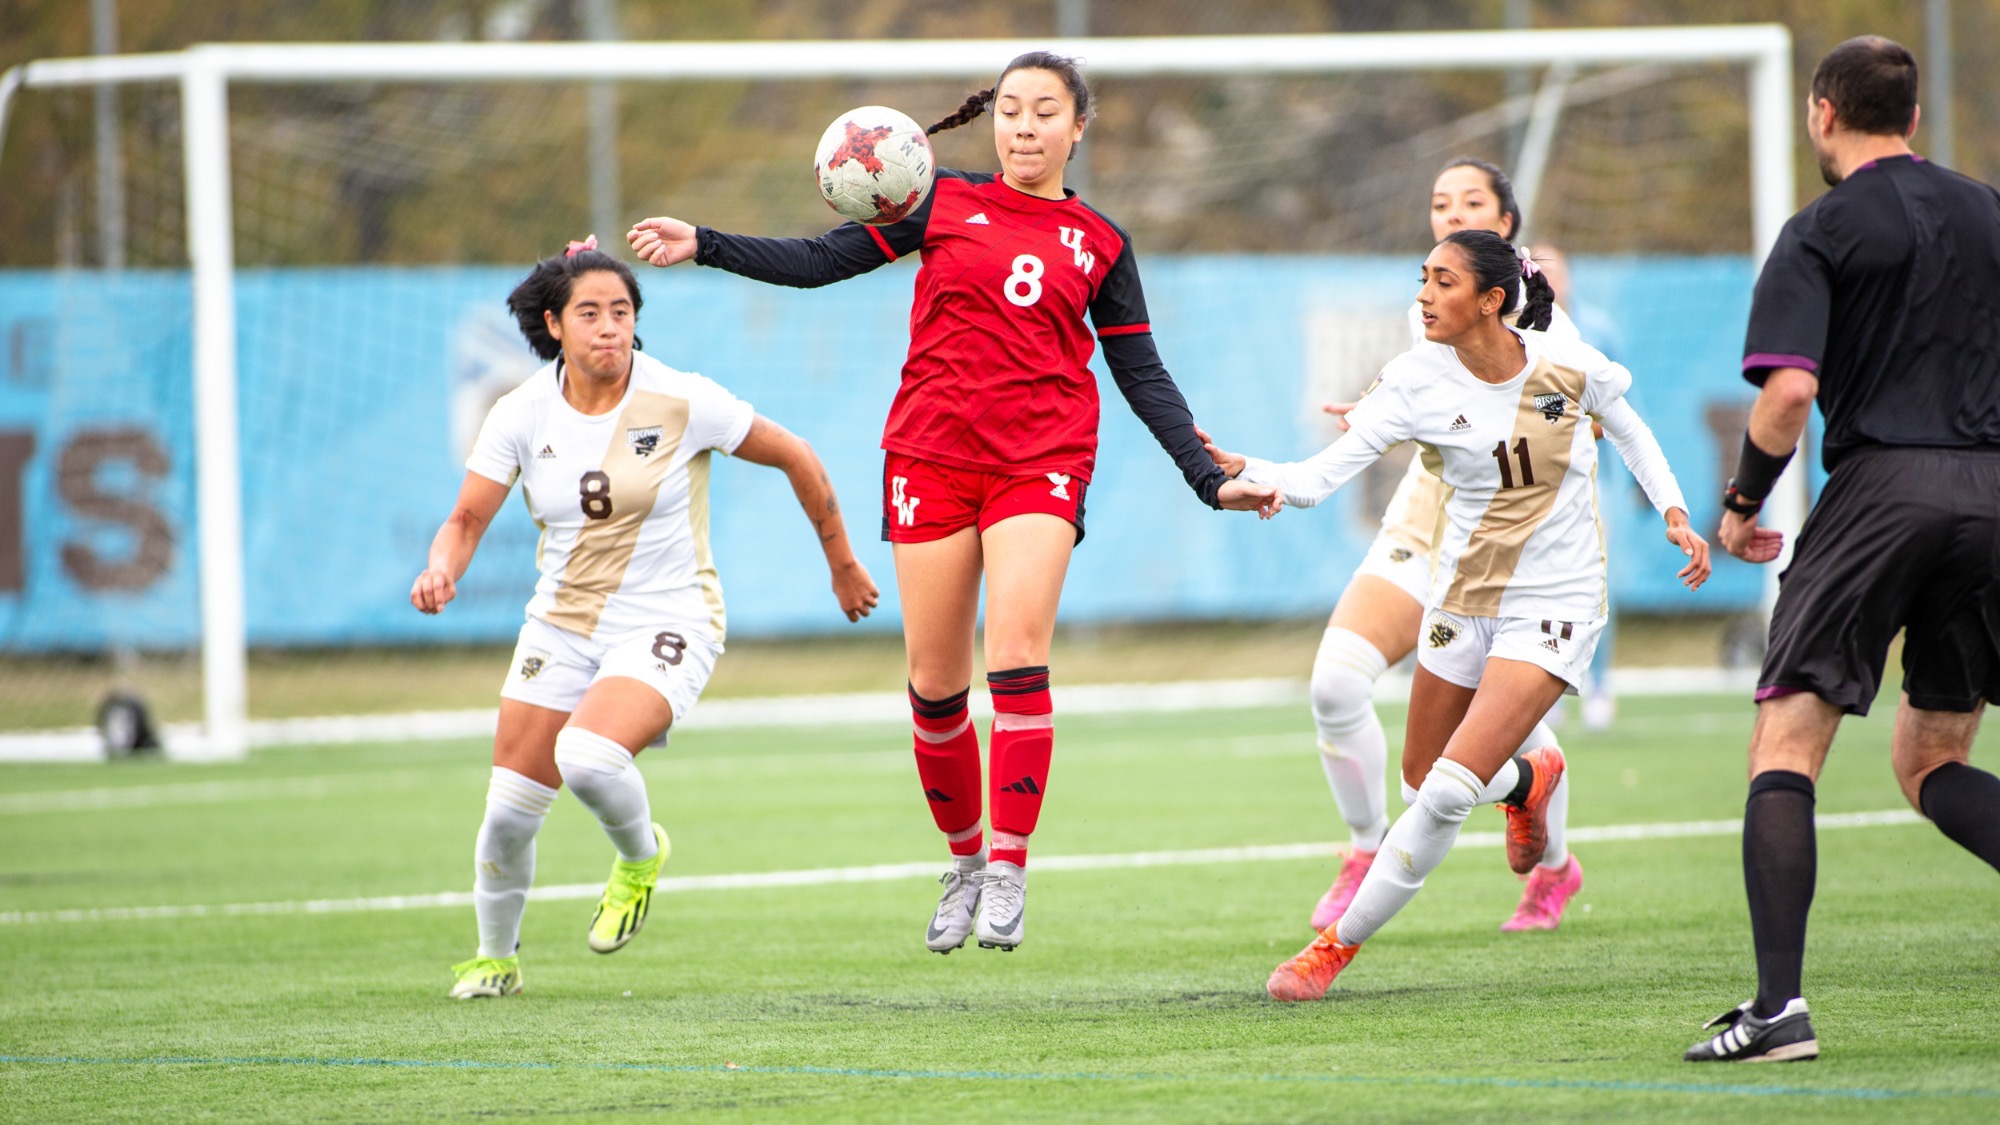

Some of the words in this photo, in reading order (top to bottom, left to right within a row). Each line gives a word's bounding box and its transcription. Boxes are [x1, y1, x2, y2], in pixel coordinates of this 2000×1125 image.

[1058, 225, 1095, 275] UW
[1003, 253, 1045, 307] 8
[1492, 437, 1534, 488] 11
[579, 470, 613, 520] 8
[651, 631, 687, 666] 8
